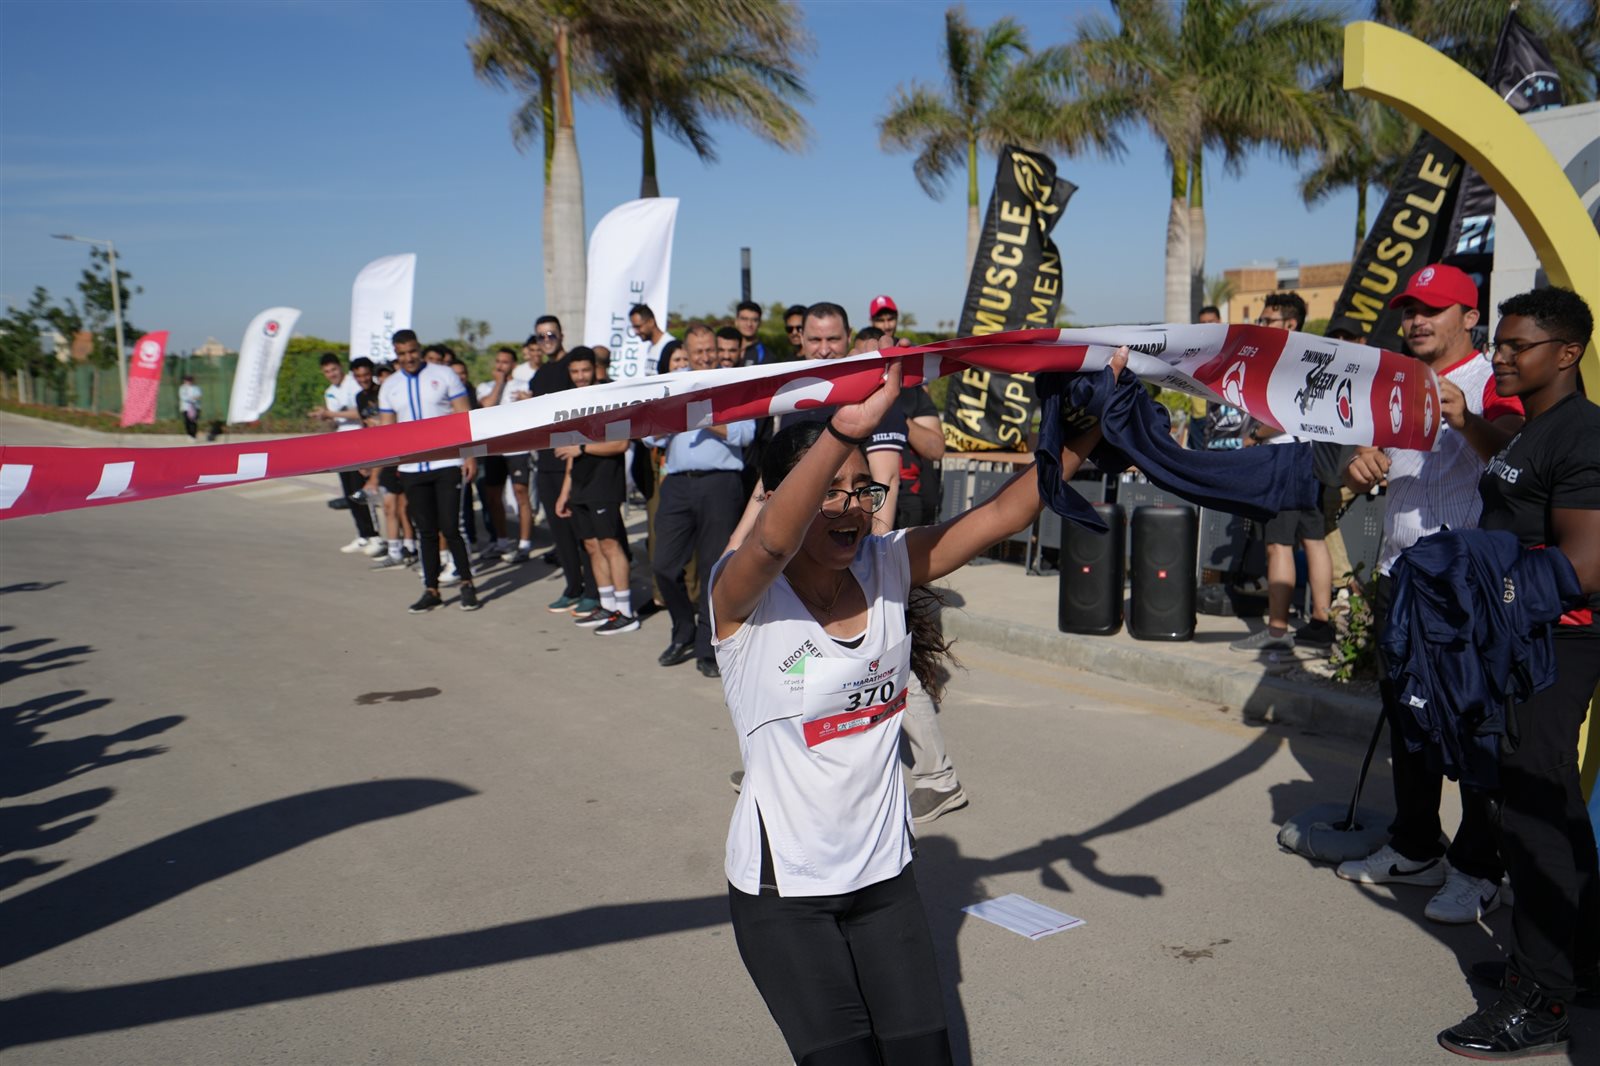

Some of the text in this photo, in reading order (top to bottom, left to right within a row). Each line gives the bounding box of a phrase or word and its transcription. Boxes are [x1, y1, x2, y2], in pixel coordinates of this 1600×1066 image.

[972, 199, 1033, 337] MUSCLE
[1345, 152, 1453, 333] MUSCLE
[369, 331, 381, 357] DIT
[607, 312, 625, 378] REDIT
[623, 280, 645, 378] GRICLE
[957, 366, 991, 433] ALE
[778, 645, 806, 673] LEROY
[853, 668, 895, 687] MARATHON
[844, 680, 895, 712] 370
